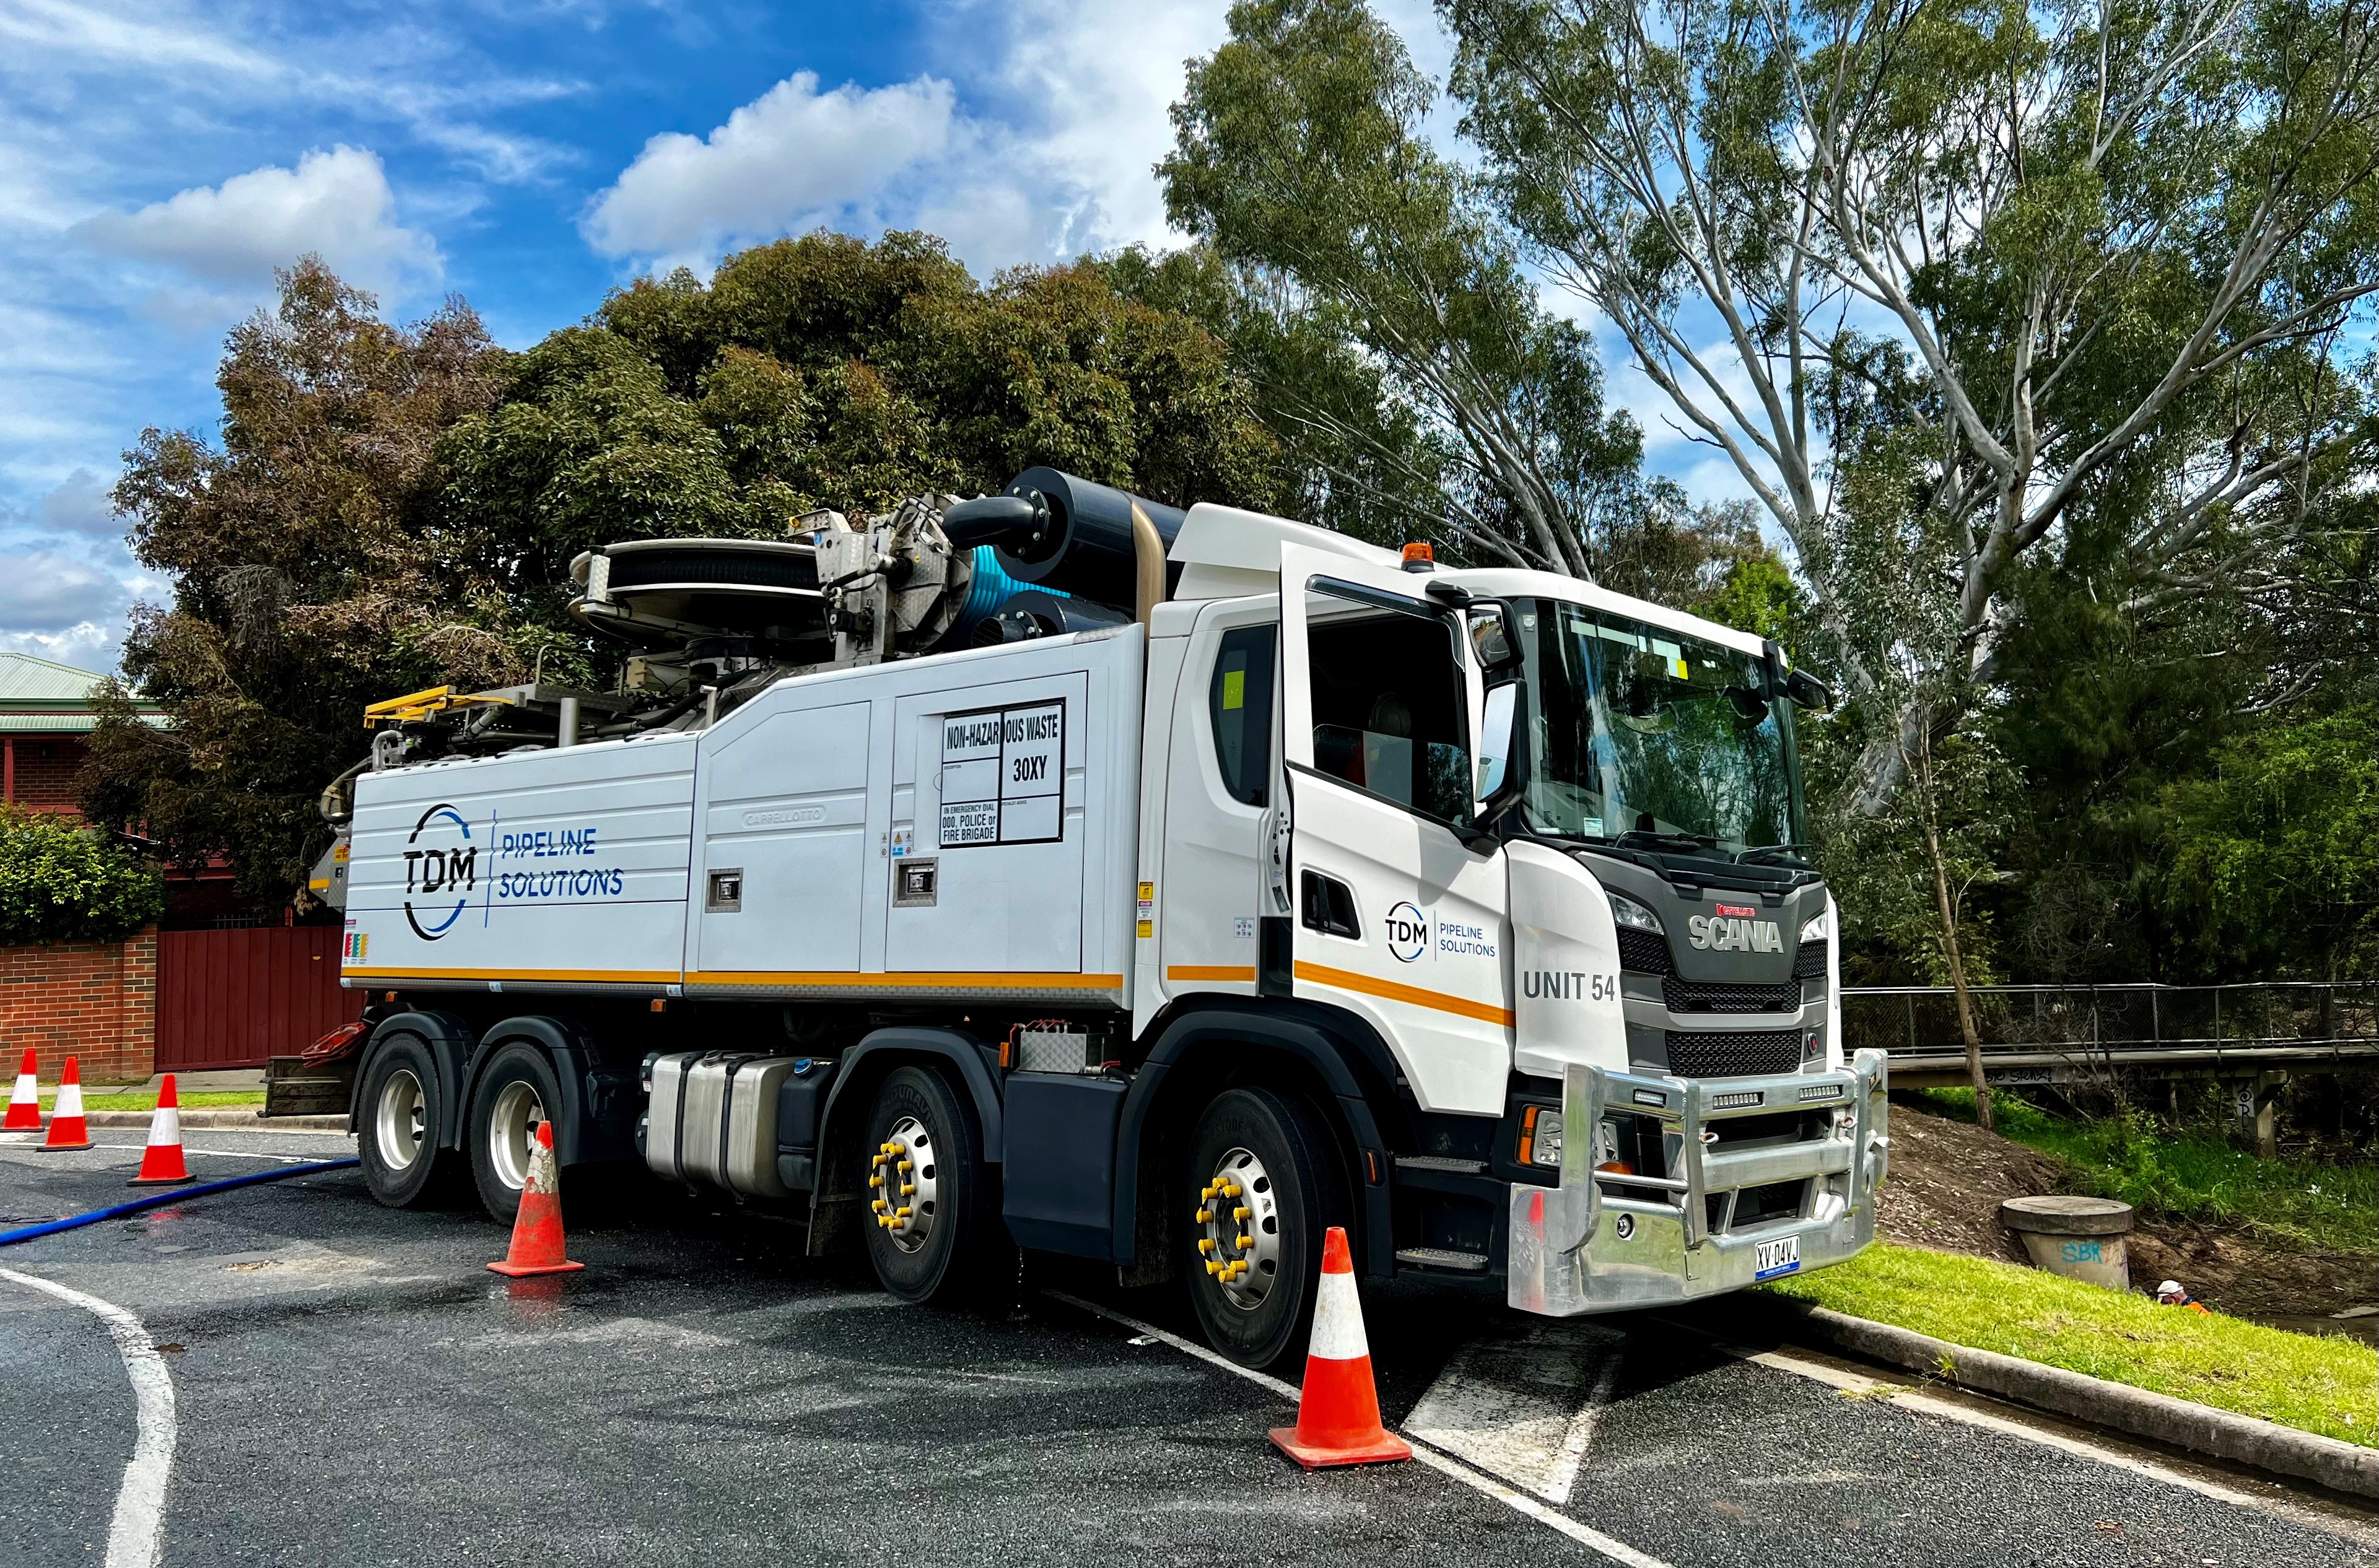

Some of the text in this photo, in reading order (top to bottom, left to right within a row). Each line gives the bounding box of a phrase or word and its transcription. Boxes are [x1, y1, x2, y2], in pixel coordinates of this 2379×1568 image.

[1026, 713, 1058, 741] WASTE
[1013, 755, 1048, 782] 30XY
[951, 804, 981, 814] EMERGENCY
[982, 803, 995, 811] DIAL
[960, 813, 986, 827] POLICE
[988, 816, 996, 825] or
[502, 828, 597, 860] PIPELINE
[943, 827, 994, 842] FIRE BRIGADE
[403, 846, 476, 894] TDM
[498, 868, 624, 898] SOLUTIONS
[1386, 918, 1427, 945] TDM
[1440, 923, 1483, 940] PIPELINE
[1688, 915, 1784, 954] SCANIA
[1440, 939, 1495, 957] SOLUTIONS
[1523, 970, 1615, 1001] UNIT 54
